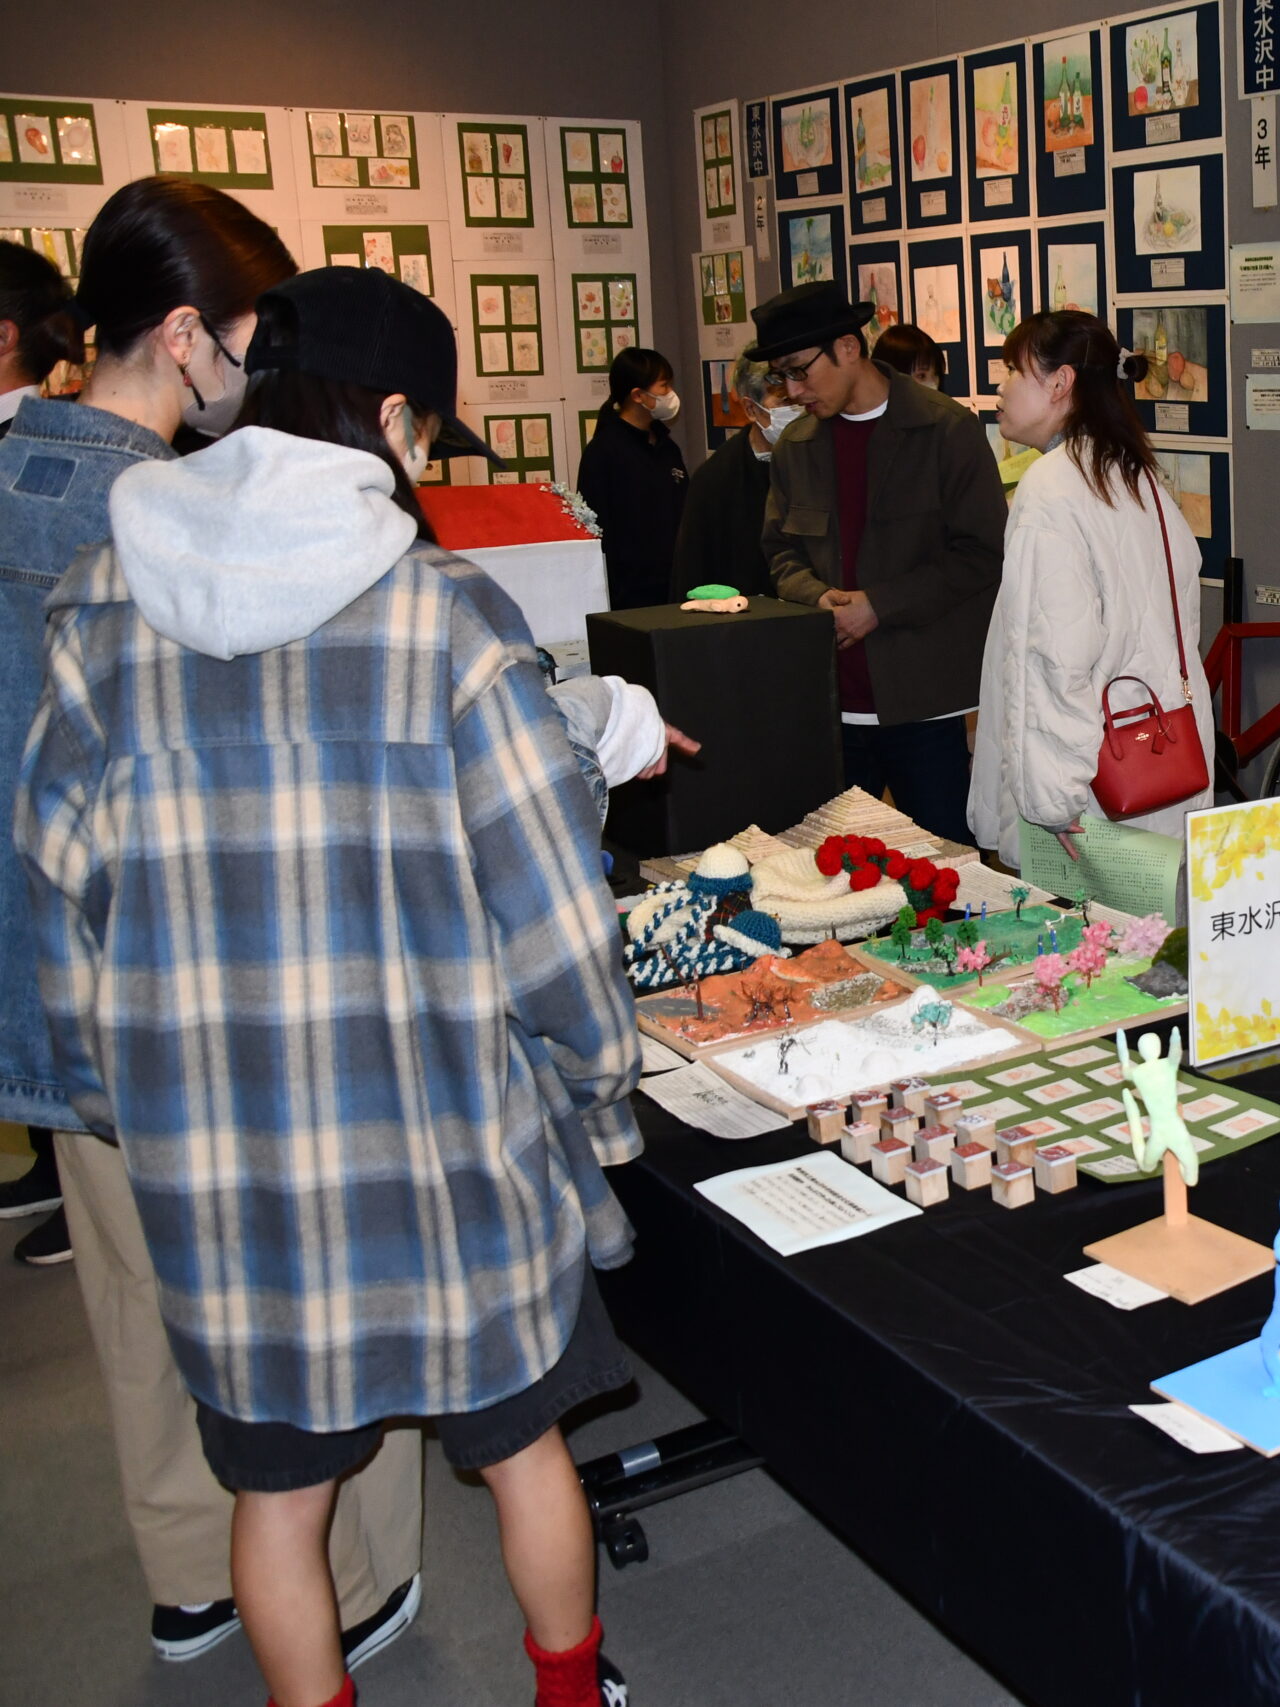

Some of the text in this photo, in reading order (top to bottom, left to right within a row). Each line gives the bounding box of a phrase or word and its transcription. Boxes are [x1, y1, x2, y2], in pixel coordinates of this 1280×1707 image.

[752, 107, 763, 174] 東水沢中
[1254, 118, 1271, 171] 3年
[756, 196, 764, 232] 2年
